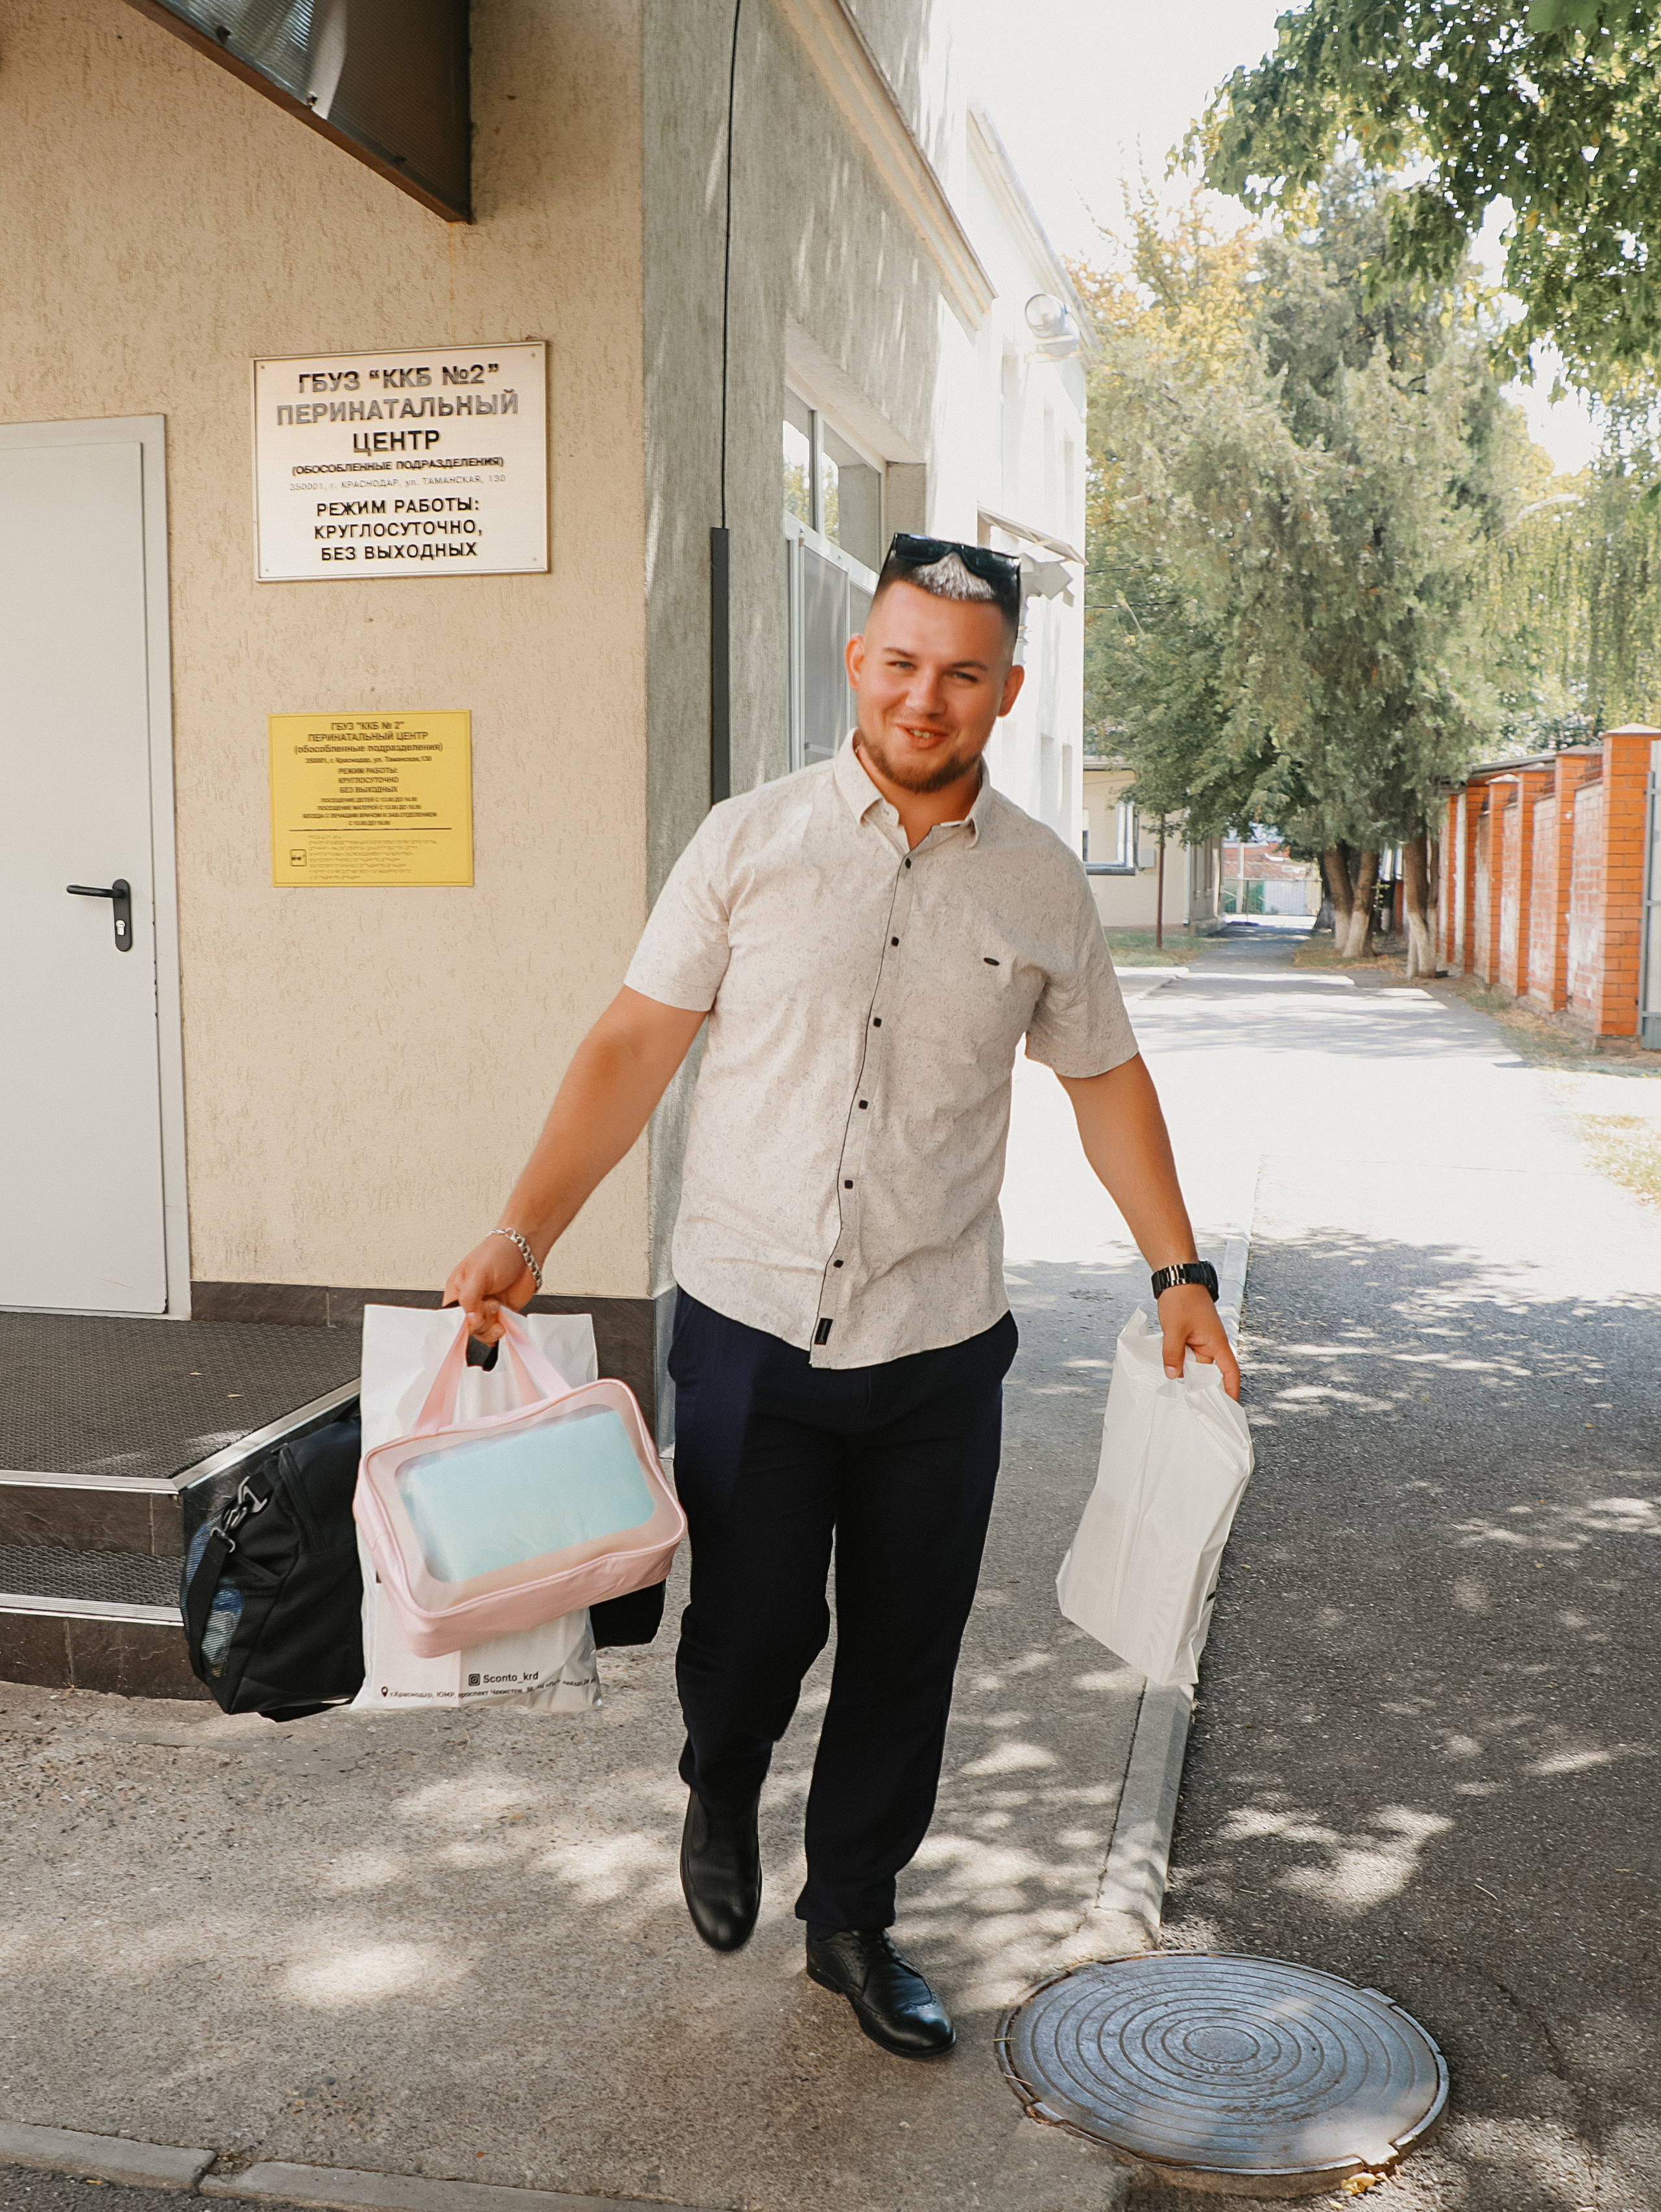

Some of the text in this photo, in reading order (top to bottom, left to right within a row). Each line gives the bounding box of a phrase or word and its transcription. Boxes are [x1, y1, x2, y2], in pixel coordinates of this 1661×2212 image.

[298, 371, 360, 393] ГБУЗ
[276, 389, 518, 426] ПЕРИНАТАЛЬНЫЙ
[353, 430, 441, 456] ЦЕНТР
[292, 456, 504, 476] (ОБОСОБЛЕННЫЕ ПОДРАЗДЕЛЕНИЯ)
[317, 496, 481, 517] РЕЖИМ РАБОТЫ:
[314, 518, 483, 540] КРУГЛОСУТОЧНО,
[321, 541, 478, 562] БЕЗ ВЫХОДНЫХ
[308, 731, 429, 742] ПЕРИНАТАЛЬНЫЙ ЦЕНТР
[331, 722, 354, 731] ГБУЗ
[483, 1671, 539, 1684] Sconto_krd
